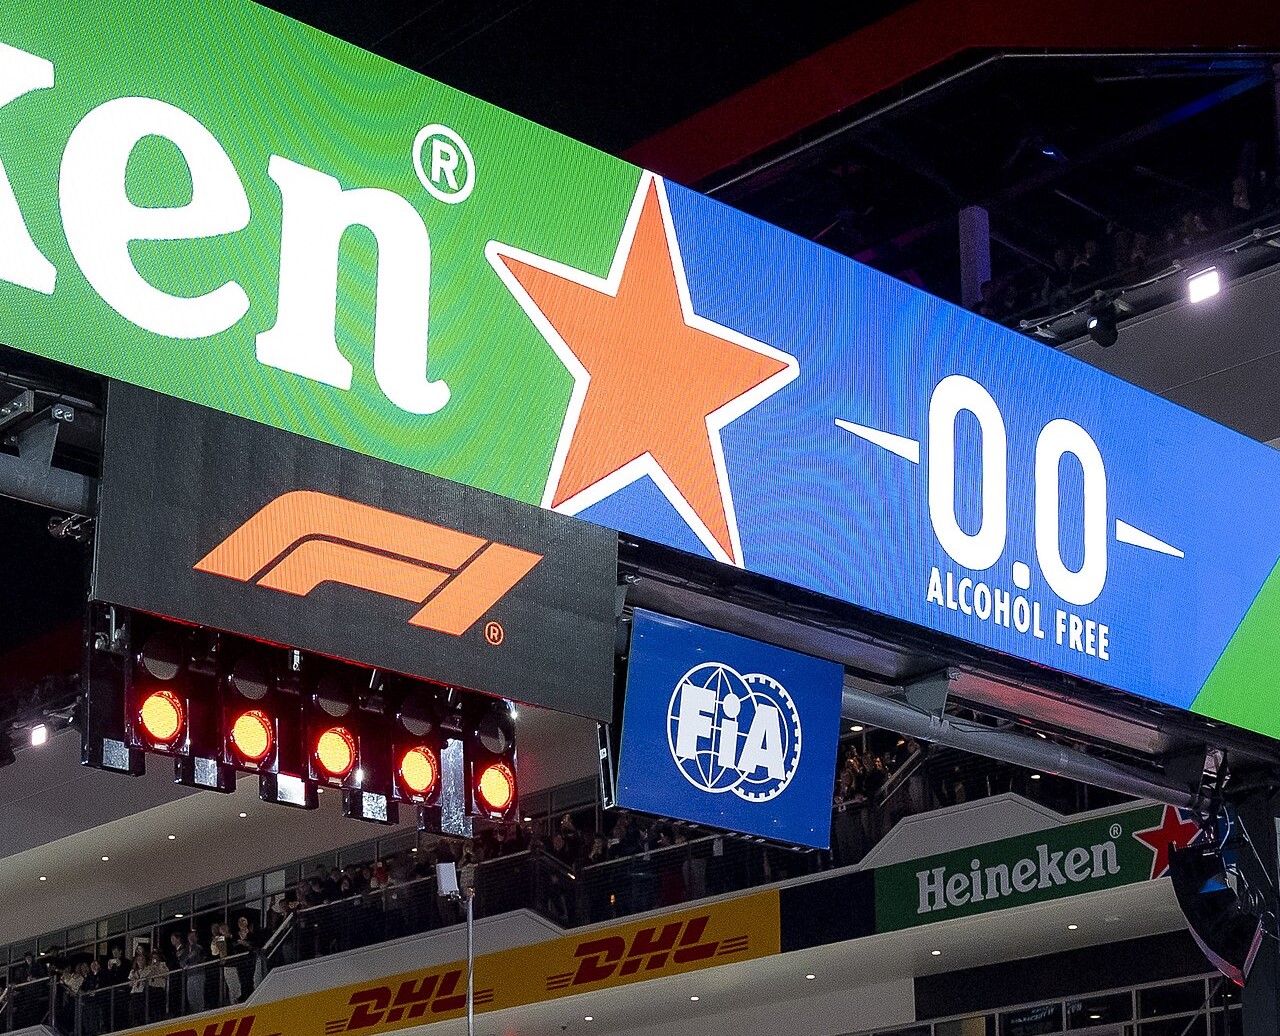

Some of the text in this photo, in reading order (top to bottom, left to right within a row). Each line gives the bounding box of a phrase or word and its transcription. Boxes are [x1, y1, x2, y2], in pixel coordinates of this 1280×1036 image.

[928, 373, 1108, 606] 0.0
[926, 567, 1111, 661] ALCOHOL FREE
[916, 839, 1121, 914] Heineken
[570, 916, 721, 986] DHL
[345, 970, 469, 1031] DHL
